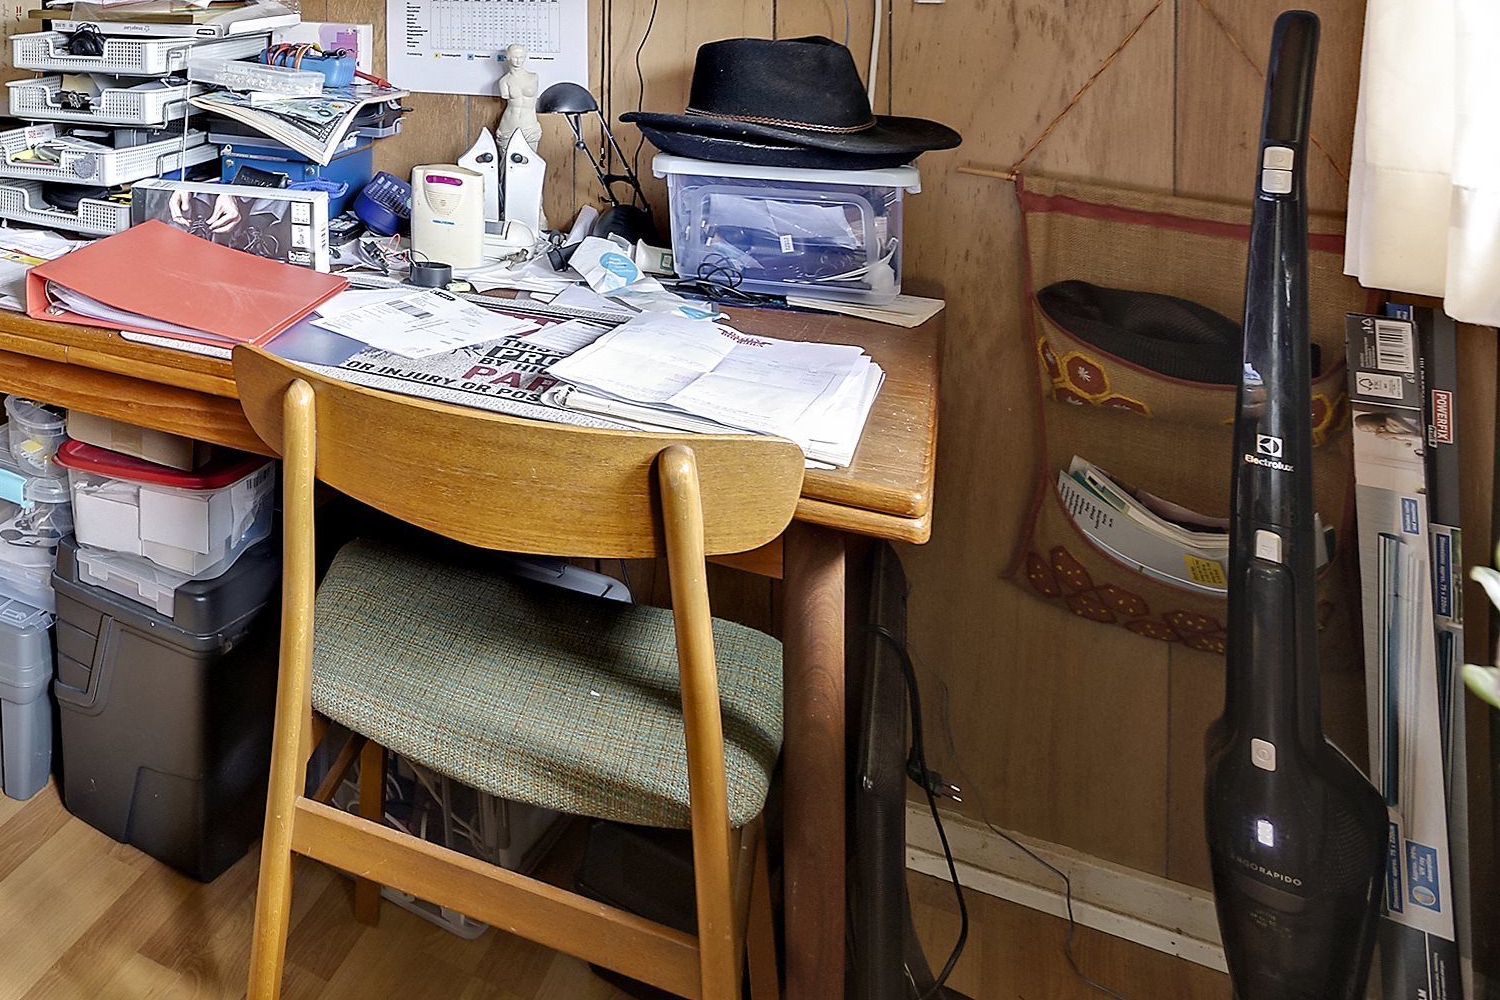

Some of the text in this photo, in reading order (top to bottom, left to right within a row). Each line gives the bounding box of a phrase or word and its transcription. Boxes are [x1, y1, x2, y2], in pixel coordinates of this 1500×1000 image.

[479, 357, 509, 367] BY
[347, 360, 373, 373] OR
[378, 366, 457, 387] INJURY
[460, 381, 493, 395] OR
[1436, 393, 1449, 442] POWERFIX
[1245, 453, 1295, 473] Electrolux
